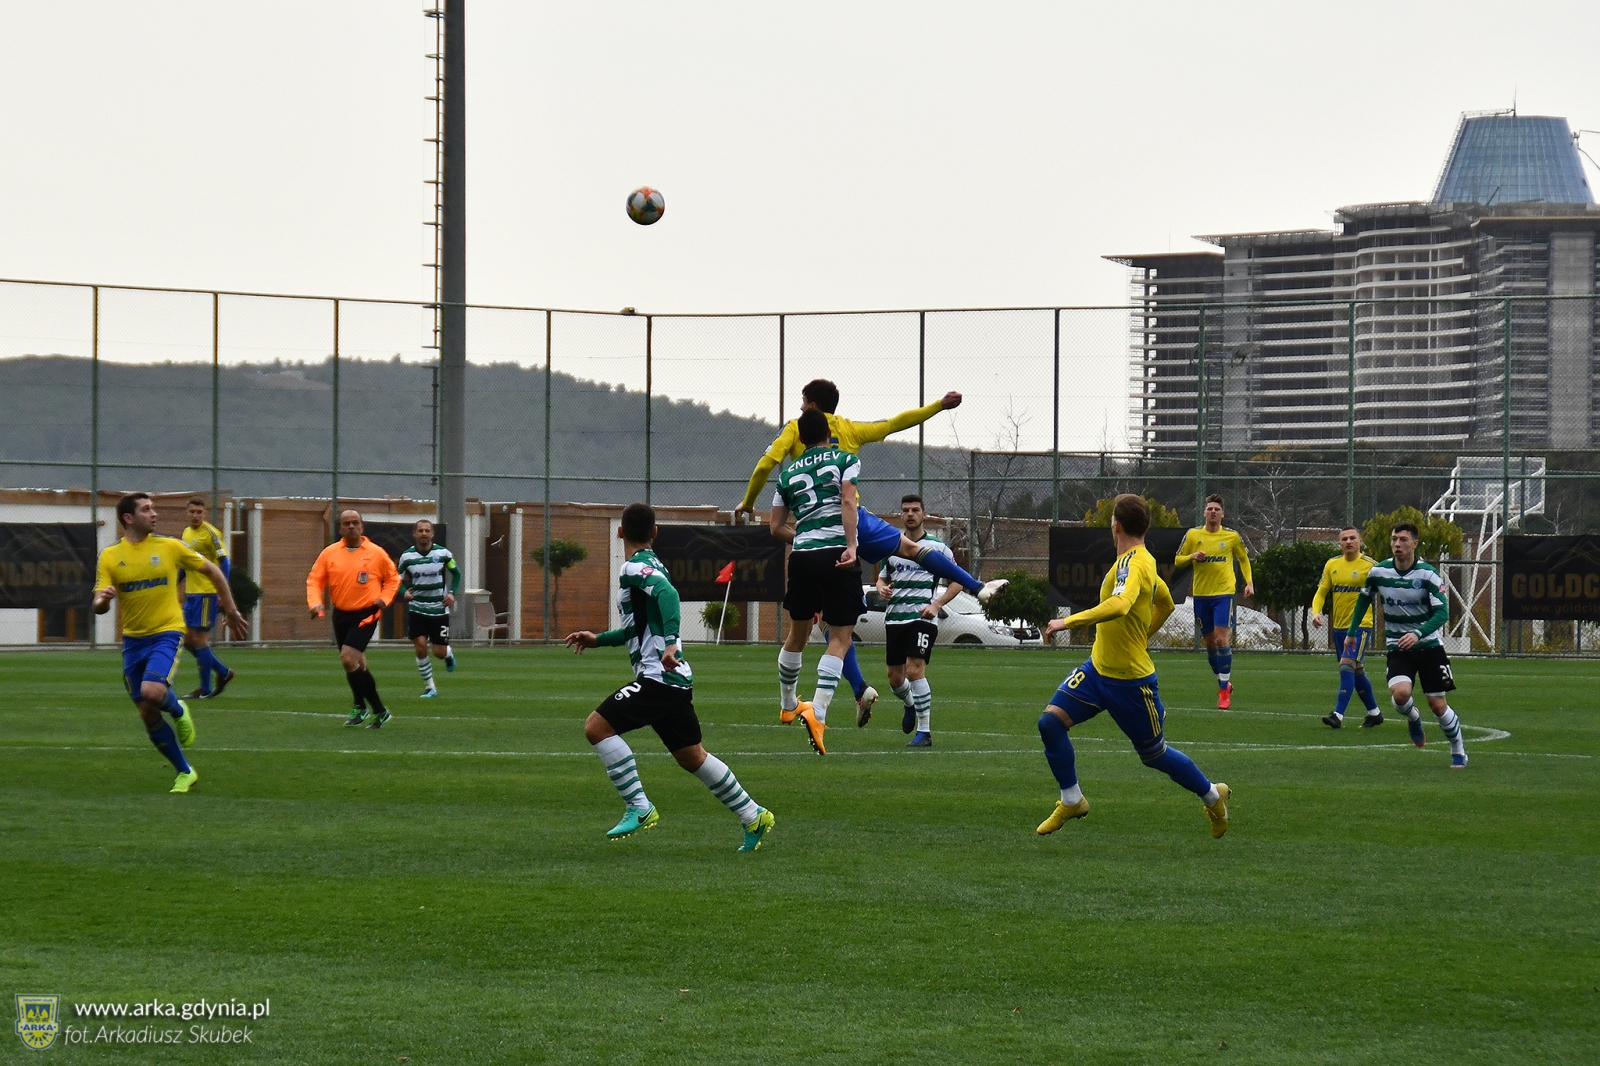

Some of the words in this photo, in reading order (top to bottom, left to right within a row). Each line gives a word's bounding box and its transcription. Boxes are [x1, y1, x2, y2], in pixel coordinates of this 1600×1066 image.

[787, 450, 841, 473] ENCHEV
[788, 464, 842, 513] 33
[917, 632, 930, 649] 16
[1063, 667, 1086, 690] 18
[1439, 664, 1453, 680] 31
[620, 682, 642, 698] 2
